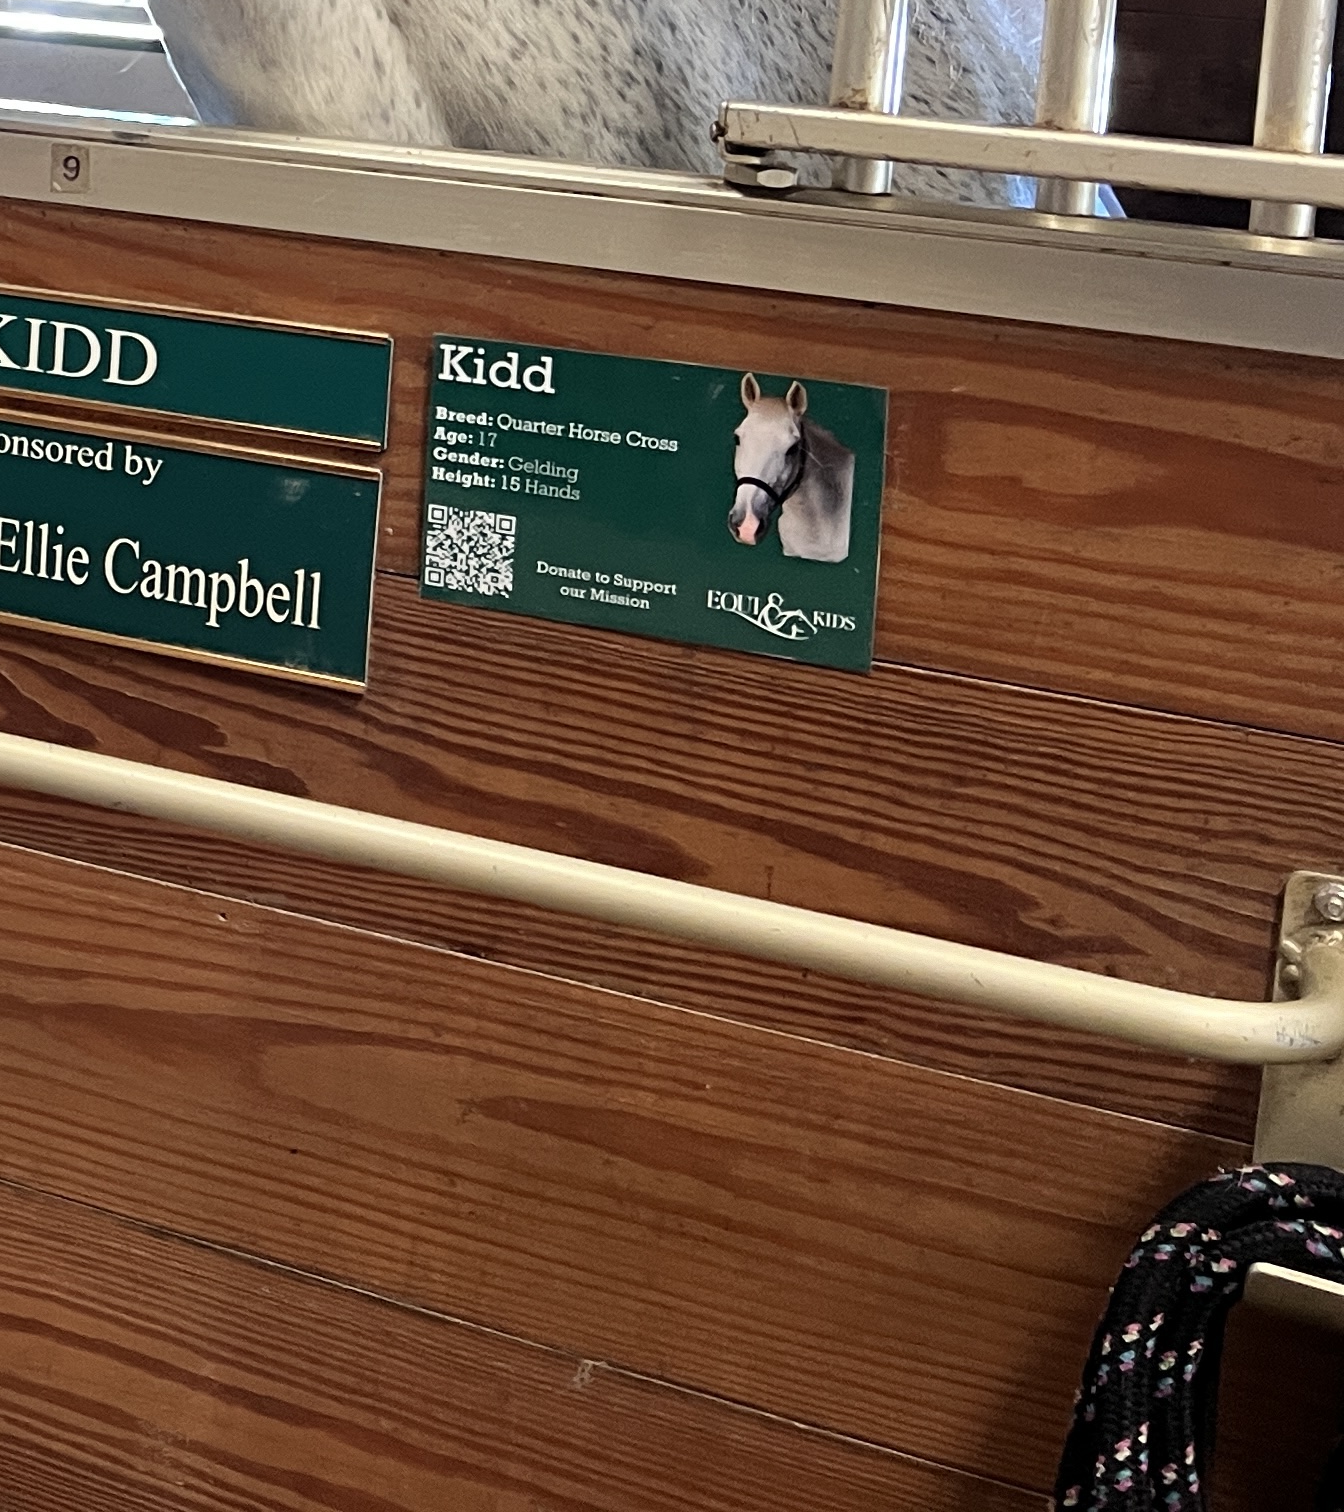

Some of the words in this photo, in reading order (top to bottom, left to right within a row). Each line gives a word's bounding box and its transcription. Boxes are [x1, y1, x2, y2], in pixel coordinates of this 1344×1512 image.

[63, 155, 80, 181] 9
[437, 343, 556, 395] Kidd
[433, 427, 474, 447] Age:
[477, 432, 498, 448] 17
[435, 406, 494, 427] Breed:
[496, 412, 564, 437] Quarter
[568, 422, 622, 445] Horse
[625, 430, 679, 453] Cross
[123, 446, 164, 485] by
[432, 447, 505, 470] Gender:
[508, 456, 579, 484] Gelding
[432, 466, 496, 491] Height:
[500, 475, 521, 493] 15
[524, 479, 581, 501] Hands
[104, 536, 322, 630] Campbell
[536, 560, 591, 580] Donate
[594, 568, 611, 584] to
[613, 572, 678, 596] Support
[559, 585, 587, 599] our
[590, 588, 651, 610] Mission
[707, 589, 762, 617] EQUI
[812, 610, 857, 632] KIDS
